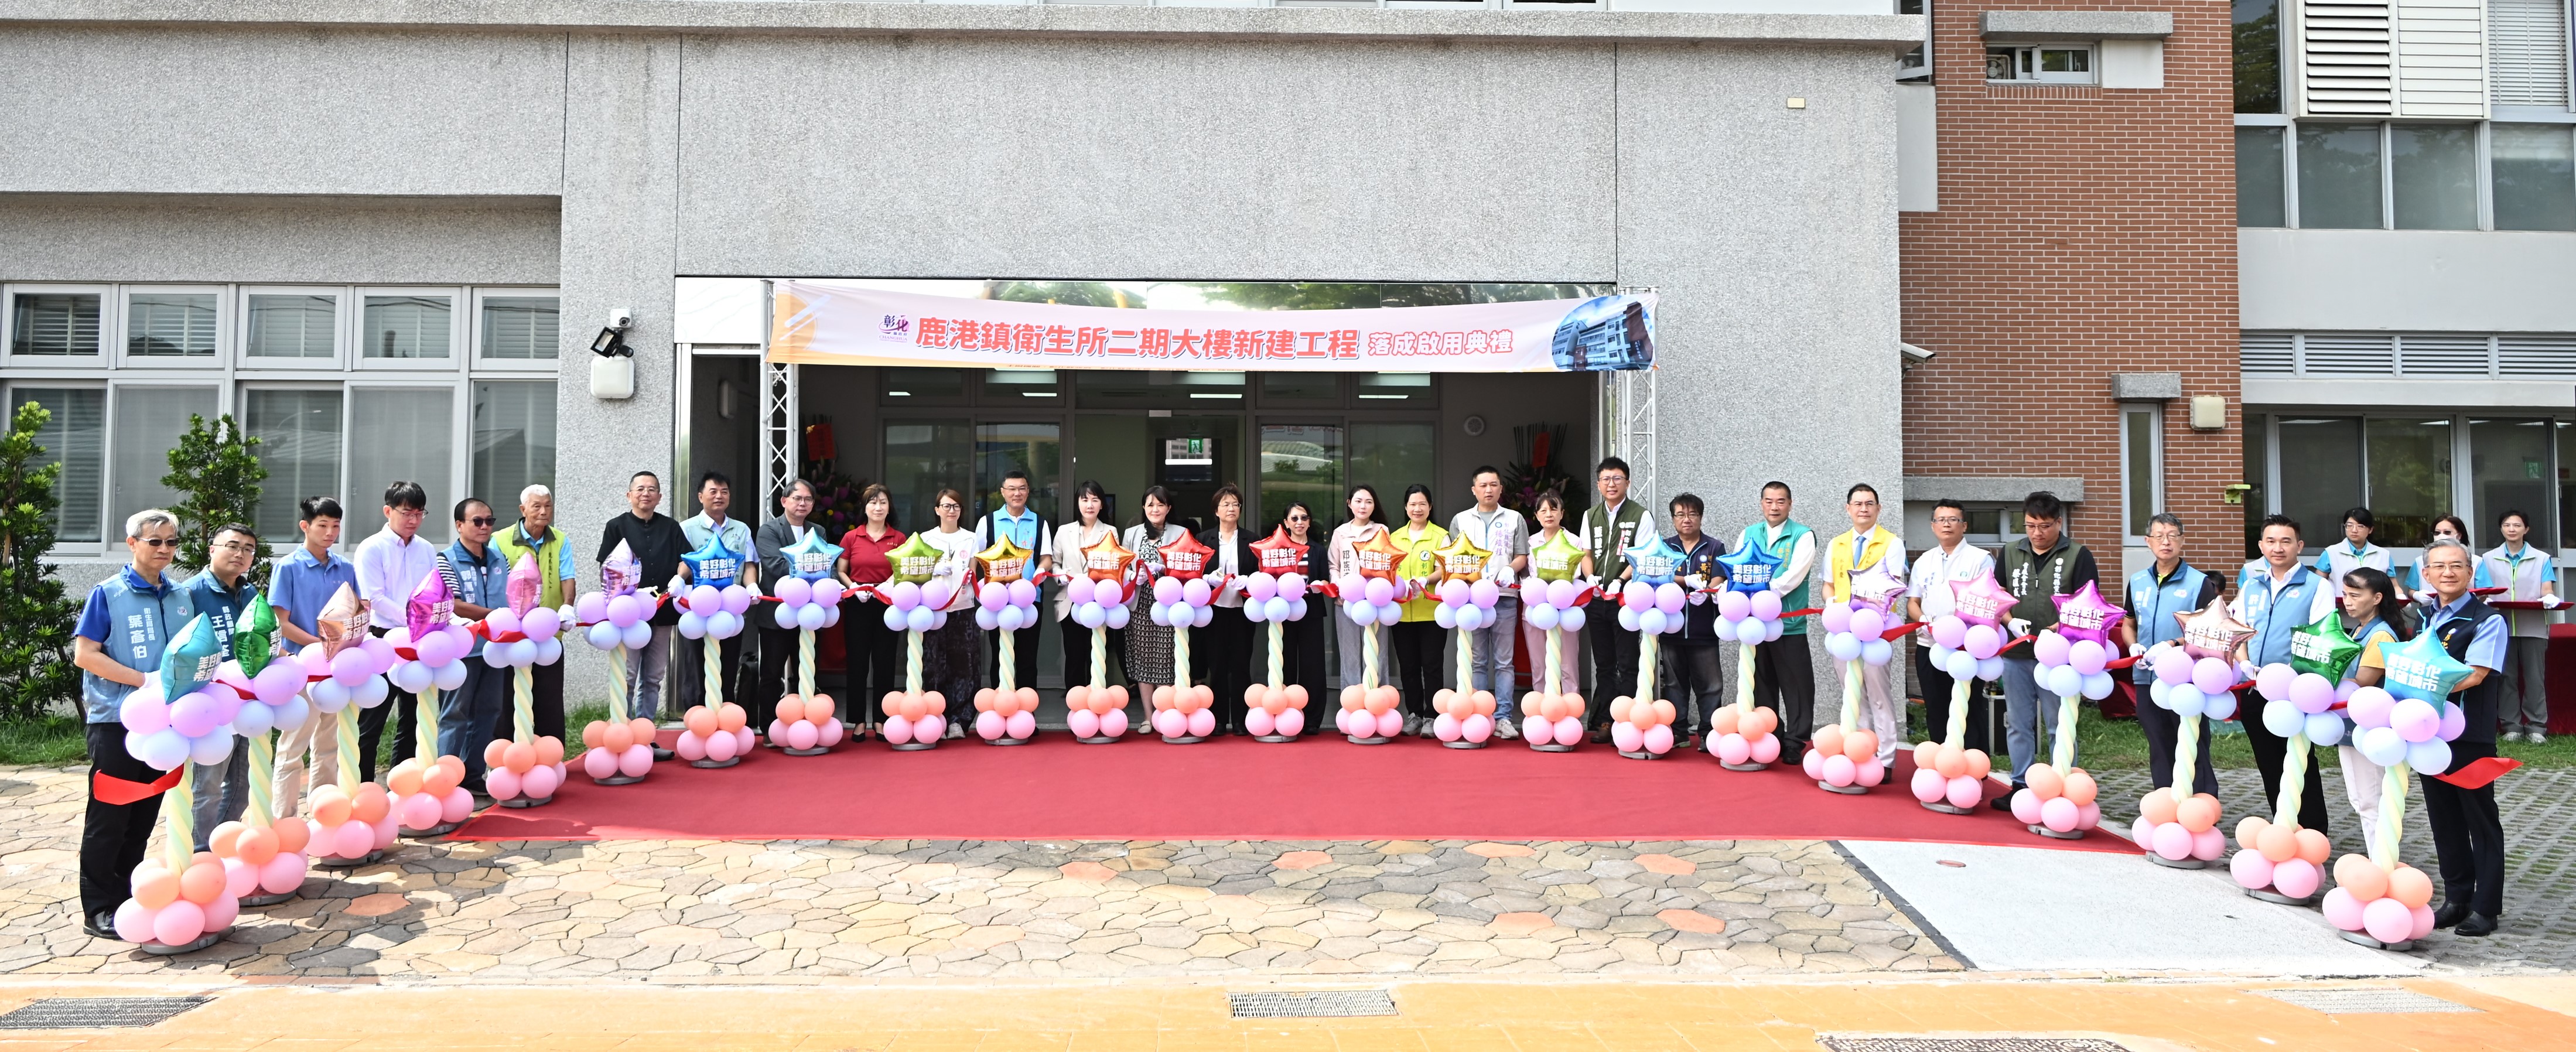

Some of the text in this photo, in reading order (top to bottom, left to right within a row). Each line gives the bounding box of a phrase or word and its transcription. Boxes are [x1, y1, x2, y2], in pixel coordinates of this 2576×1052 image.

[915, 317, 1513, 360] 鹿港鎮衛生所二期大樓新建工程 落成啟用典禮
[699, 558, 736, 570] 美好彰化
[901, 556, 935, 566] 美好彰化
[699, 568, 735, 579] 希望城市
[901, 566, 934, 575] 希望城市
[1733, 564, 1771, 574] 美好彰化
[1733, 574, 1771, 583] 希望城市
[128, 614, 148, 659] 葉彥伯
